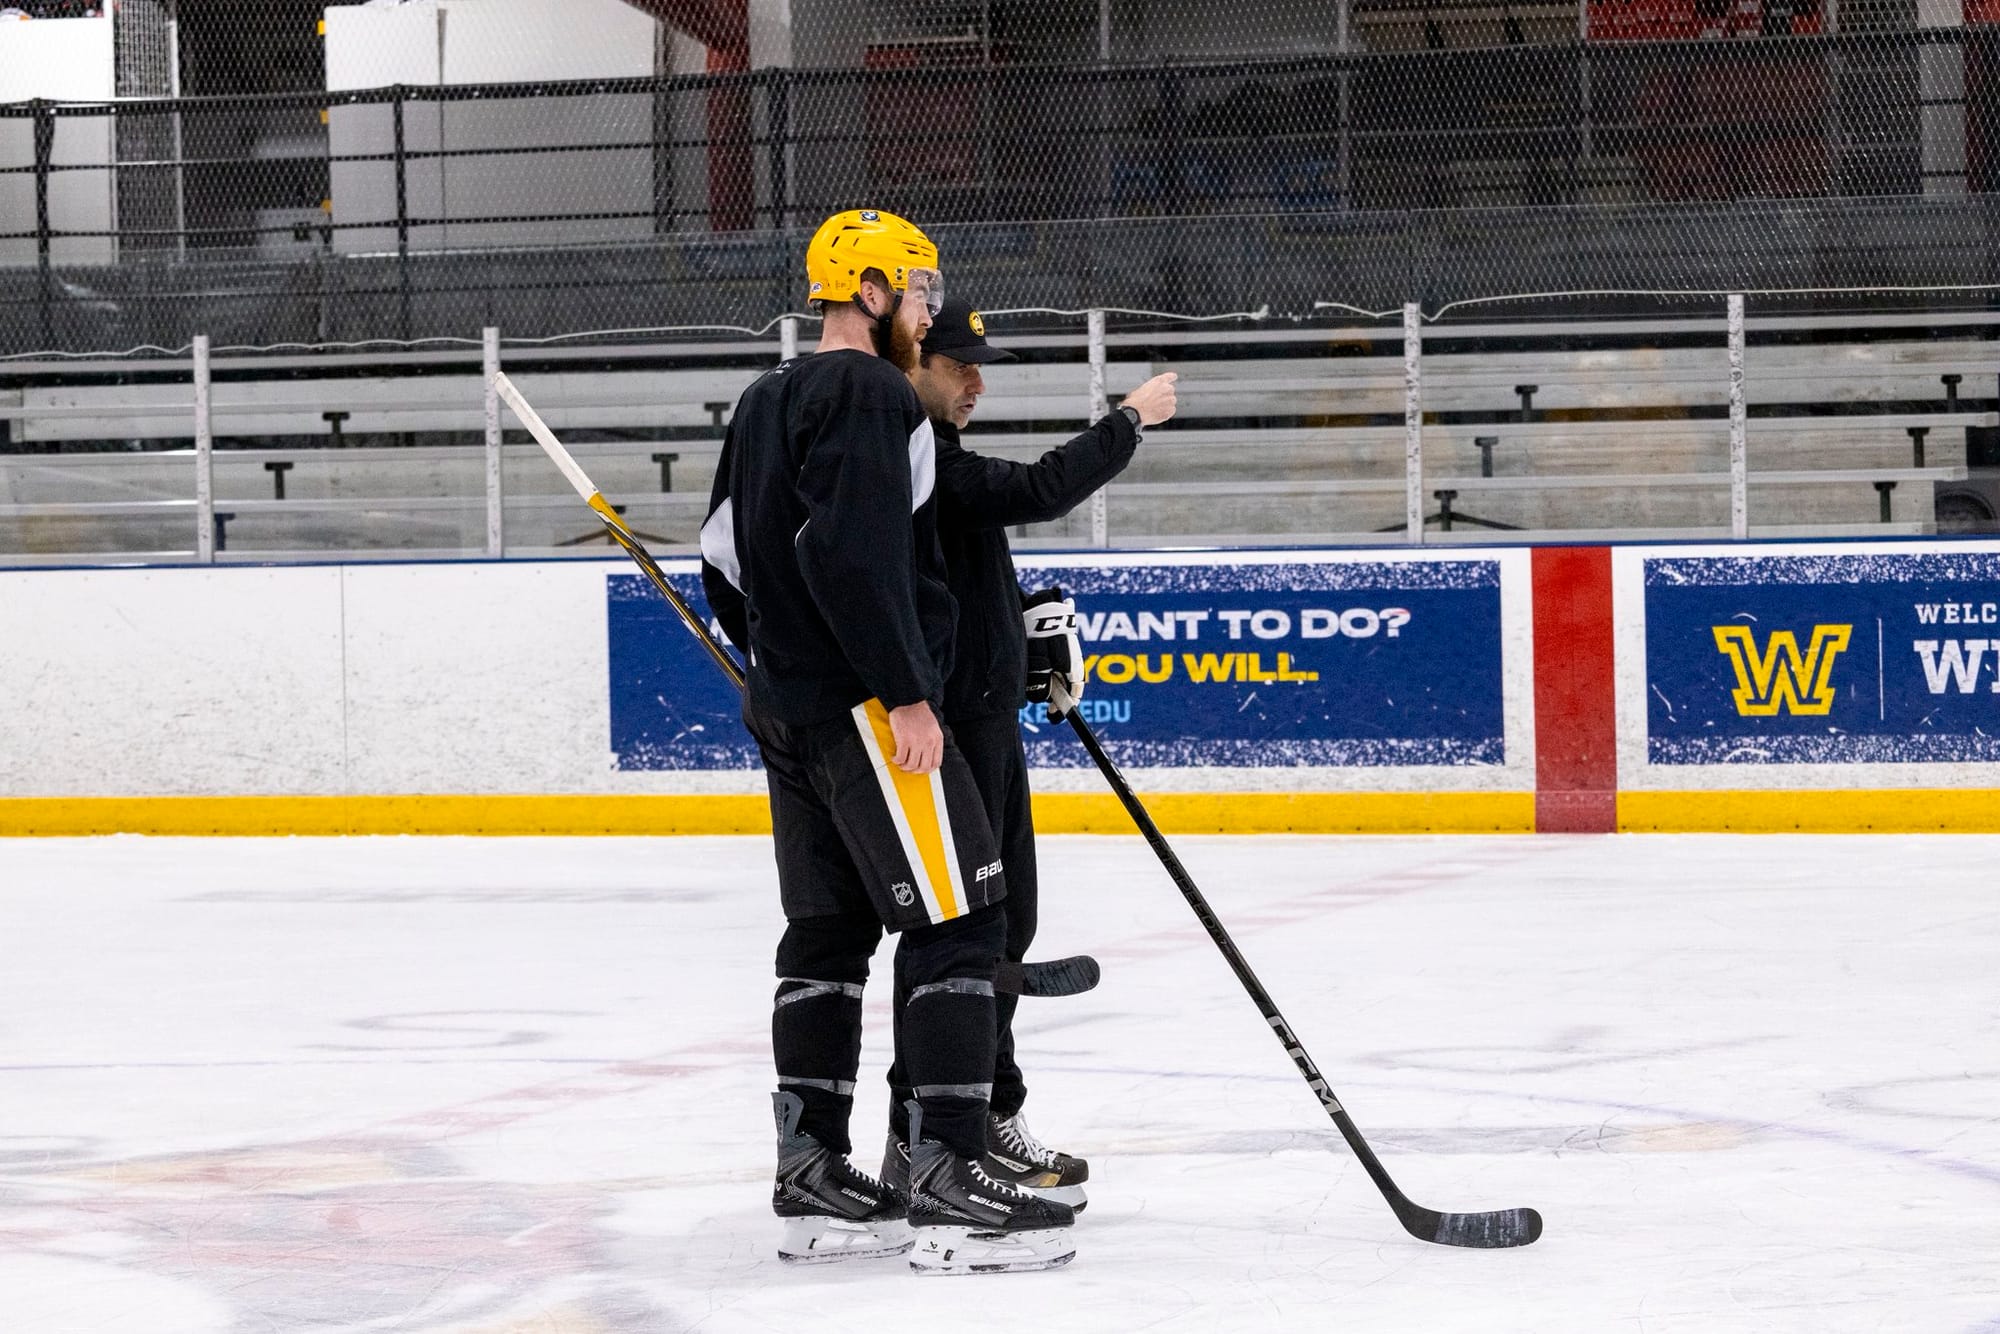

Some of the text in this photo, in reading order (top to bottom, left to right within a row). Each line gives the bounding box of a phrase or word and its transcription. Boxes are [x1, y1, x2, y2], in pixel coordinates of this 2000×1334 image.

[1218, 609, 1291, 640] TO
[1301, 607, 1411, 639] DO?
[1183, 652, 1319, 683] WILL.
[1913, 639, 2000, 694] W
[1267, 1015, 1342, 1114] CCM
[840, 1187, 878, 1207] BAUER
[968, 1194, 1013, 1214] BAUER
